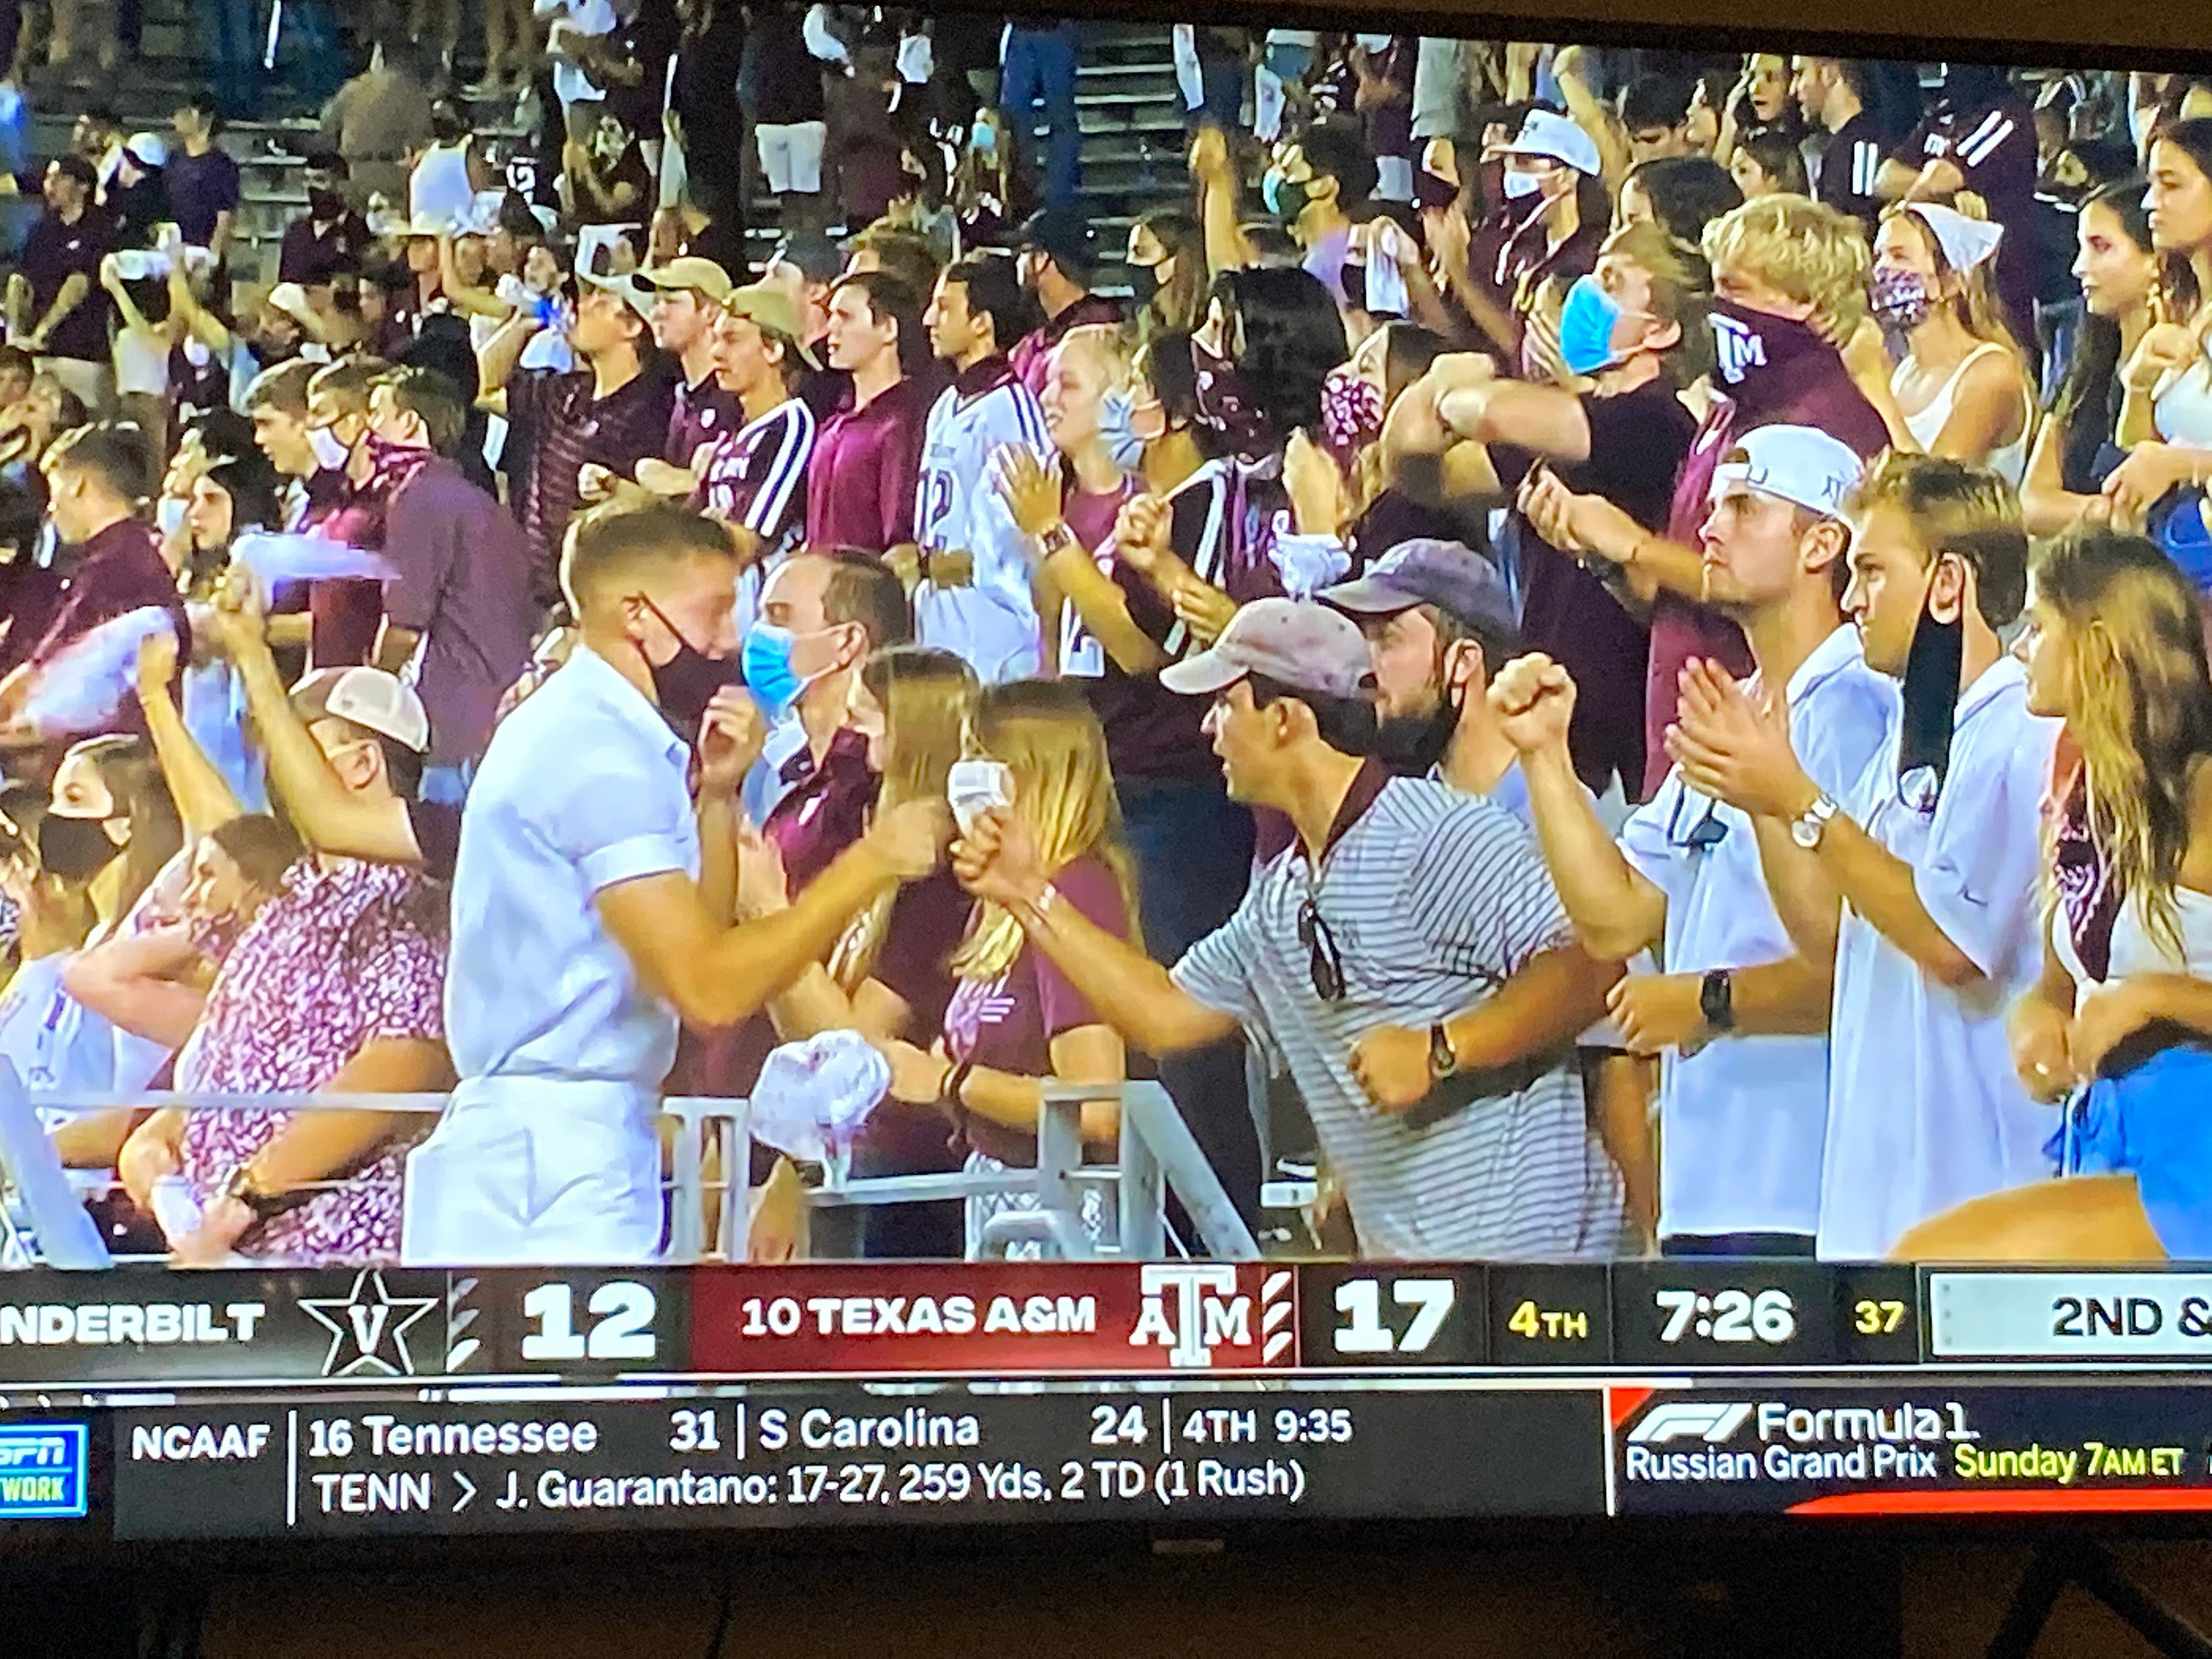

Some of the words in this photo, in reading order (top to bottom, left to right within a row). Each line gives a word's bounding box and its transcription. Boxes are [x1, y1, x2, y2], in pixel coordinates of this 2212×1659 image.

[0, 1302, 266, 1345] NDERBILT
[347, 1305, 390, 1353] V
[523, 1282, 656, 1359] 12
[741, 1298, 801, 1336] 10
[807, 1296, 976, 1335] TEXAS
[984, 1295, 1097, 1333] A&M
[1335, 1279, 1454, 1352] 17
[1508, 1301, 1587, 1338] 4TH
[1656, 1289, 1795, 1342] 7:26
[1854, 1300, 1905, 1334] 37
[2052, 1297, 2163, 1336] 2ND
[132, 1424, 270, 1460] NCAAF
[309, 1419, 353, 1457] 16
[362, 1415, 598, 1455] Tennessee
[669, 1410, 720, 1451] 31
[760, 1409, 788, 1449] S
[800, 1407, 979, 1448] Carolina
[1091, 1405, 1148, 1444] 24
[1183, 1410, 1256, 1443] 4TH
[1275, 1409, 1352, 1442] 9:35
[495, 1471, 528, 1509] J.
[537, 1468, 777, 1508] Guarantano:
[787, 1464, 890, 1505] 17-27,
[899, 1463, 971, 1501] 259
[1061, 1462, 1084, 1499] 2
[1092, 1460, 1146, 1498] TD
[1155, 1460, 1189, 1505] (1
[1198, 1459, 1305, 1502] Rush)
[1626, 1445, 1757, 1480] Russian
[1764, 1444, 1866, 1480] Grand
[1873, 1444, 1937, 1477] Prix
[1954, 1443, 2078, 1485] Sunday
[2083, 1442, 2146, 1476] 7AM
[2151, 1447, 2184, 1476] ET
[312, 1472, 431, 1512] TENN
